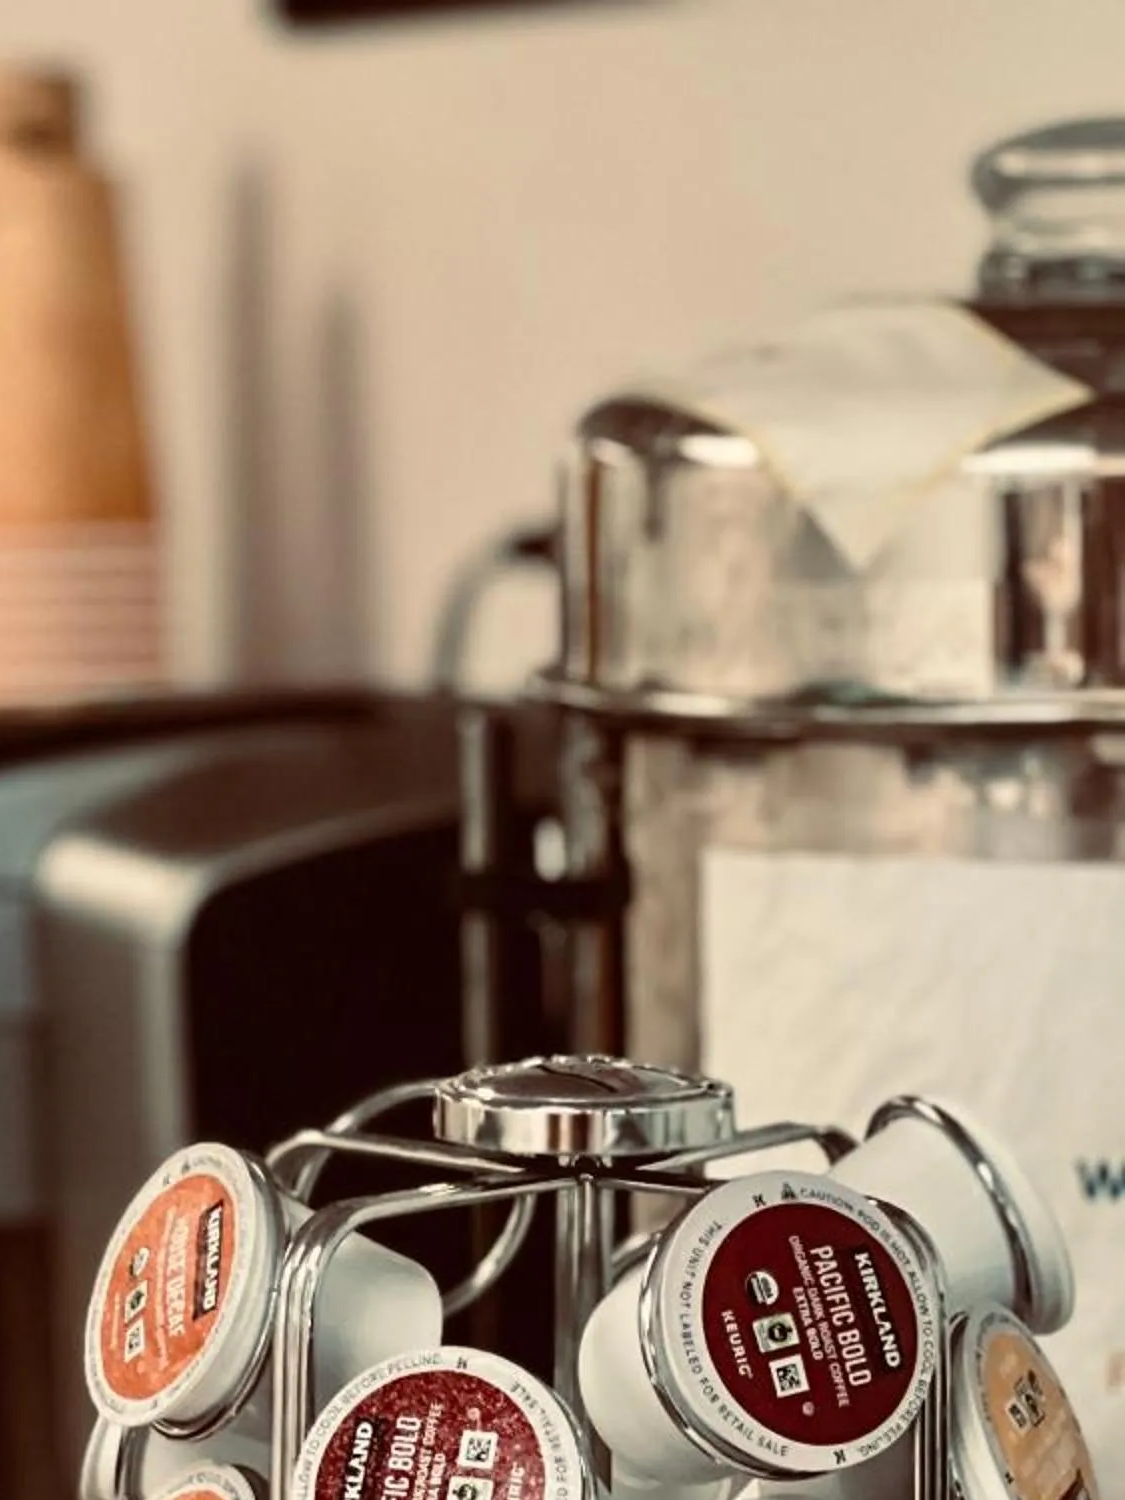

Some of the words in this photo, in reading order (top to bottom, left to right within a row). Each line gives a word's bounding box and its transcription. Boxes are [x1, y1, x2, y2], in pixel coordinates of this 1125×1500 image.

[696, 1217, 723, 1248] THIS
[202, 1206, 223, 1310] KIRKLAND
[683, 1244, 705, 1278] UNIT
[678, 1279, 693, 1308] NOT
[853, 1250, 903, 1367] KIRKLAND
[788, 1235, 814, 1287] ORGANIC
[805, 1287, 824, 1321] DARK
[815, 1321, 836, 1362] ROAST
[827, 1362, 851, 1408] COFFEE
[790, 1287, 811, 1326] EXTRA
[803, 1328, 822, 1363] BOLD
[809, 1246, 854, 1329] PACIFIC
[835, 1328, 872, 1387] BOLD
[678, 1312, 705, 1376] LABELED
[696, 1375, 721, 1406] FOR
[387, 1416, 422, 1471] BOLD
[422, 1402, 443, 1446] COFFEE
[715, 1401, 756, 1443] RETAIL
[755, 1432, 788, 1459] SALE
[415, 1448, 434, 1487] ROAST
[431, 1451, 447, 1486] BOLD
